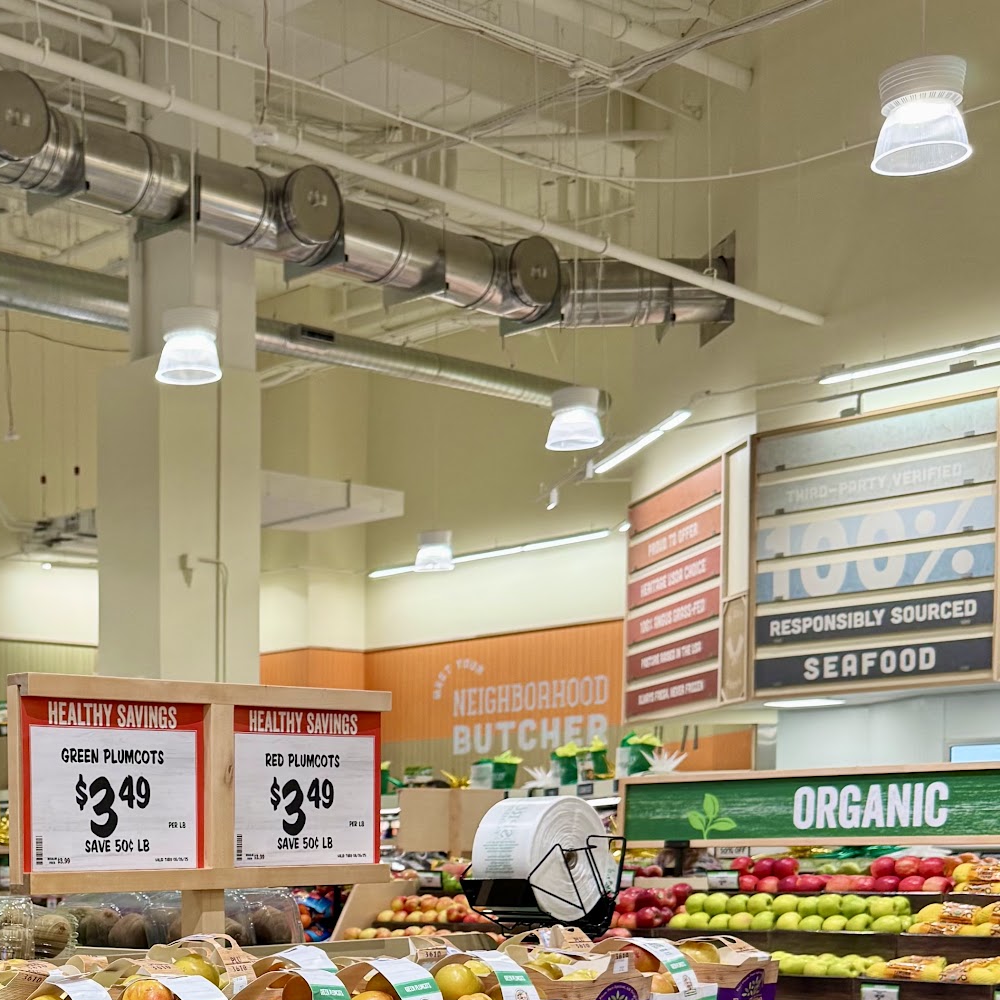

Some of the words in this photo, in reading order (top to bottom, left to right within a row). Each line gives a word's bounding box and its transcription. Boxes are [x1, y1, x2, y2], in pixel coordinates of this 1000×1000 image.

[786, 474, 888, 502] THIRD-PARTY
[892, 462, 963, 482] VERIFIED
[769, 608, 886, 637] RESPONSIBLY
[890, 598, 978, 625] SOURCED
[803, 646, 936, 681] SEAFOOD
[452, 674, 609, 718] NEIGHBORHOOD
[48, 701, 113, 727] HEALTHY
[117, 704, 177, 729] SAVINGS
[249, 710, 303, 733] HEALTHY
[307, 712, 358, 735] SAVINGS
[452, 713, 608, 755] BUTCHER
[61, 748, 99, 764] GREEN
[103, 748, 164, 765] PLUMCOTS
[265, 753, 284, 767] RED
[288, 753, 340, 768] PLUMCOTS
[792, 780, 949, 830] ORGANIC
[168, 821, 179, 829] PER
[85, 839, 111, 853] SAVE
[115, 839, 134, 853] 50¢
[137, 839, 150, 853] LB
[277, 837, 300, 850] SAVE
[303, 836, 319, 850] 50¢
[322, 836, 333, 849] LB
